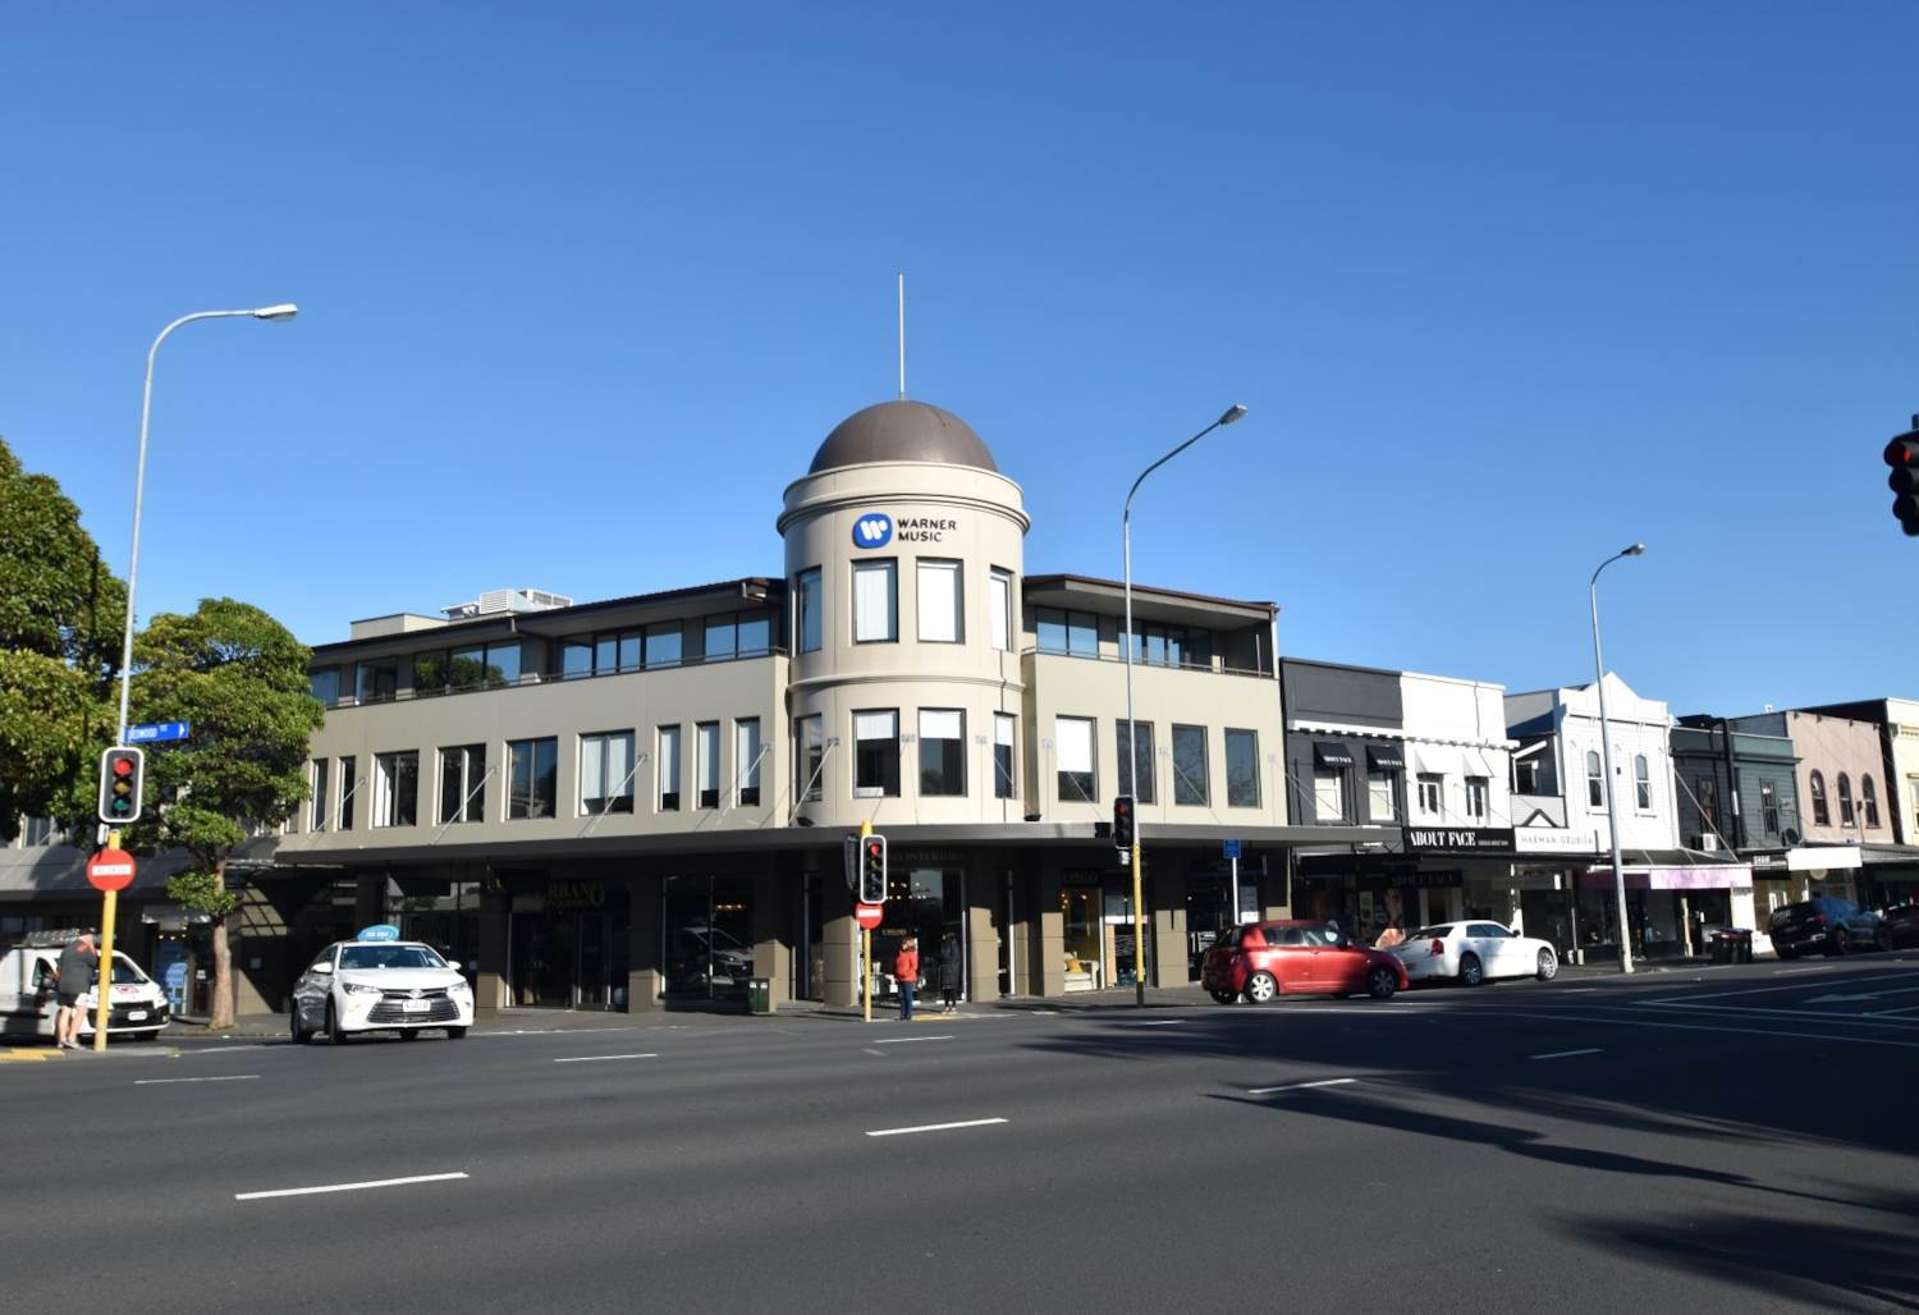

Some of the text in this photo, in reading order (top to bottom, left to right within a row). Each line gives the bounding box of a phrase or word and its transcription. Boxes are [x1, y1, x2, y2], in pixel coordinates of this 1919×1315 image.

[897, 518, 957, 530] WARNER
[898, 531, 942, 542] MUSIC
[1410, 830, 1446, 847] ABOUT
[1448, 830, 1477, 847] FACE
